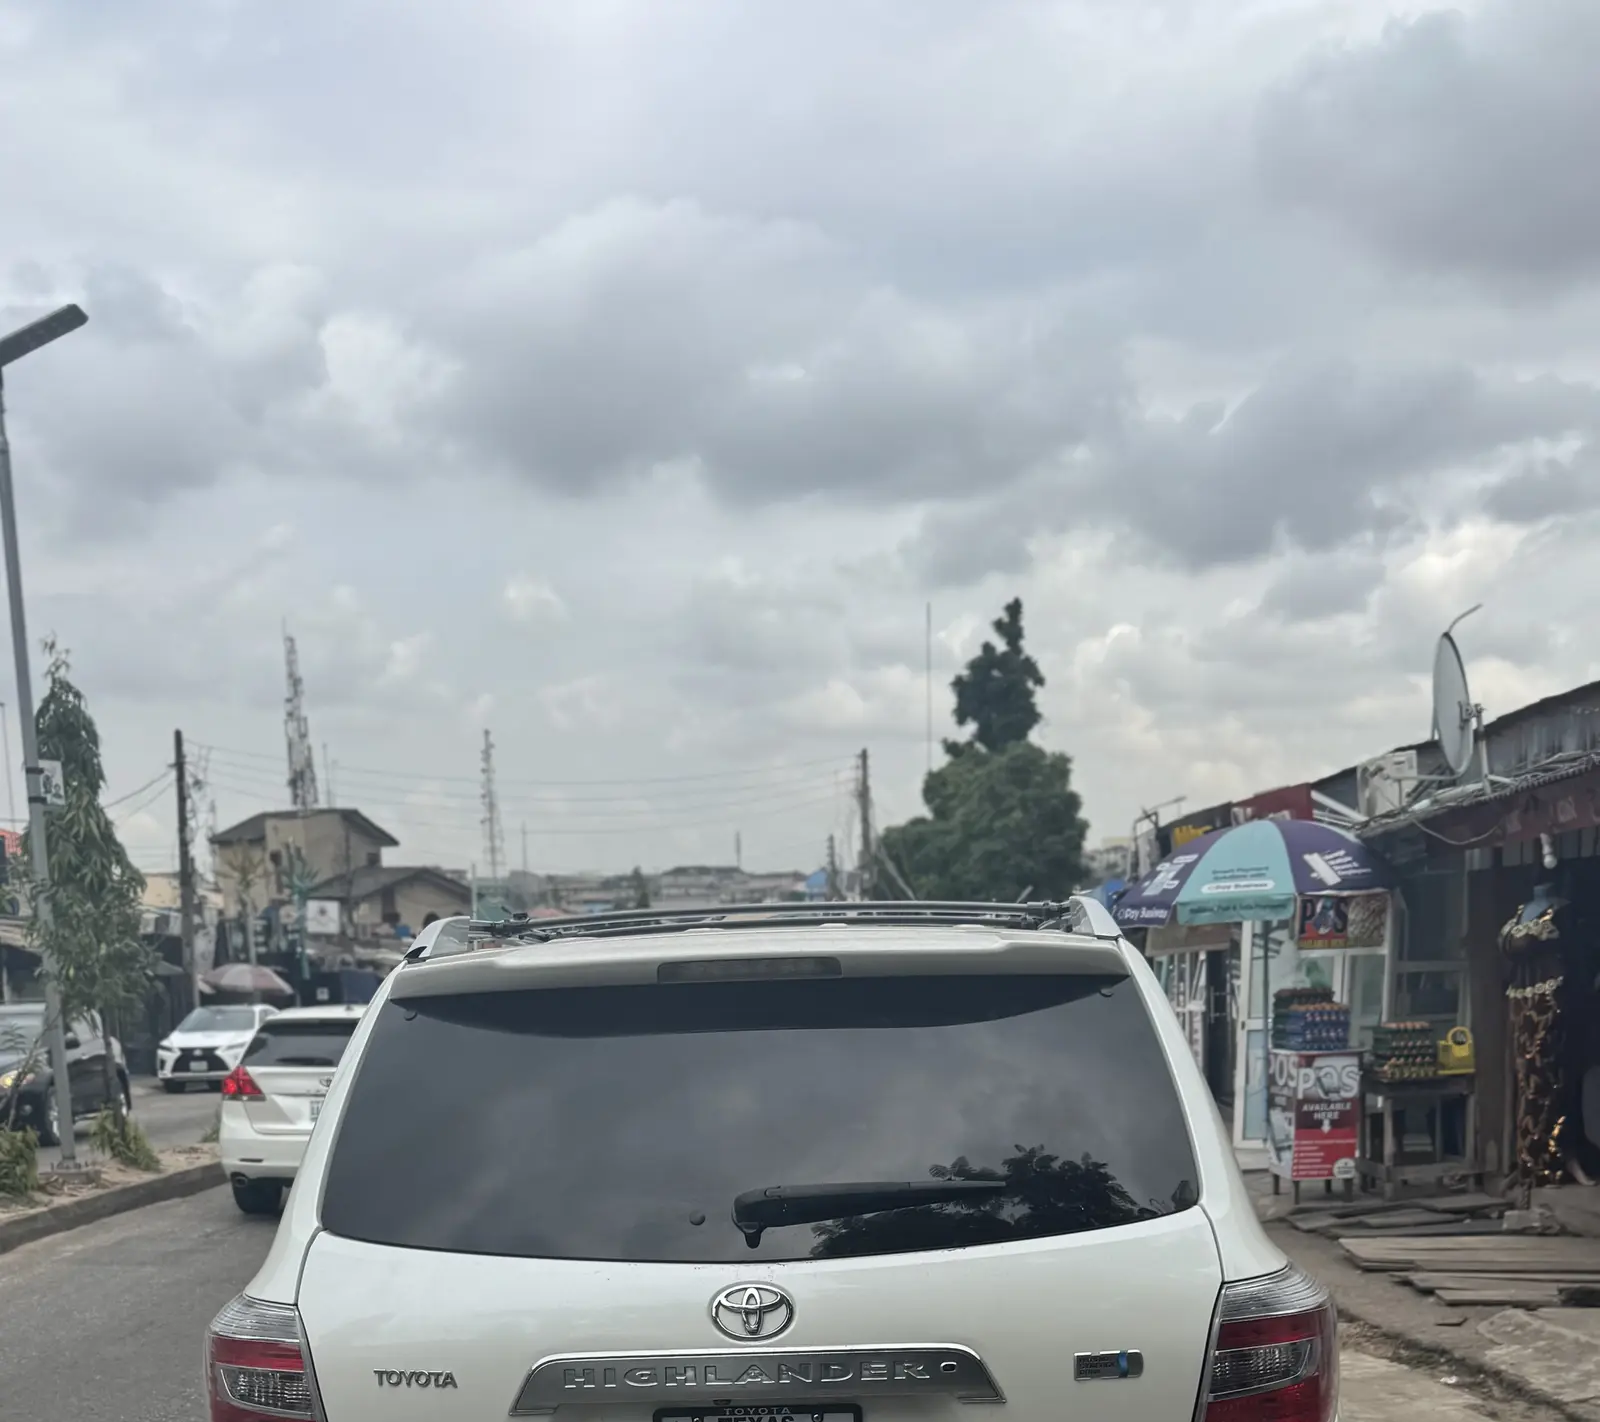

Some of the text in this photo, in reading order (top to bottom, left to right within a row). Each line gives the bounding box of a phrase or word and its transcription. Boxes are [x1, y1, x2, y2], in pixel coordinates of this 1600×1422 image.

[1297, 1065, 1359, 1100] POS
[1302, 1102, 1351, 1111] AVAILABLE
[1313, 1110, 1339, 1120] HERE
[373, 1368, 458, 1389] TOYOTA
[564, 1359, 931, 1388] HIGHLANDER
[723, 1407, 791, 1416] TOYOTA
